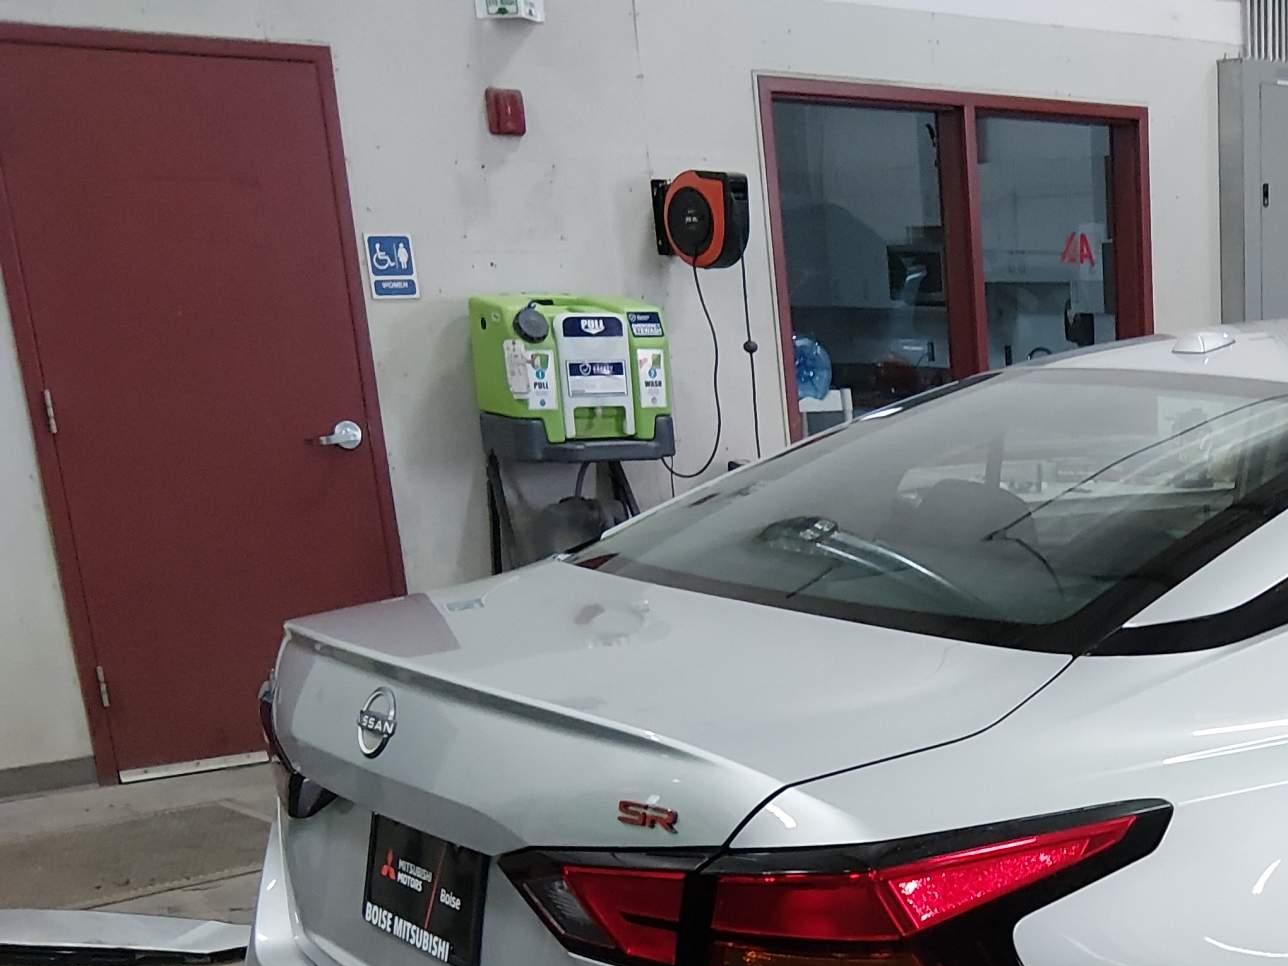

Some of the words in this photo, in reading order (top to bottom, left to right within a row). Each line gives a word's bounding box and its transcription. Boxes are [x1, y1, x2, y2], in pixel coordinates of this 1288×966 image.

[581, 319, 605, 330] PULL
[645, 380, 662, 388] WASH
[361, 714, 395, 735] SSAN
[617, 799, 679, 834] SR
[398, 858, 433, 883] MITSUBISHI
[397, 871, 423, 892] MOTORS
[440, 888, 461, 910] Boise
[365, 902, 392, 933] BOISE
[393, 916, 450, 962] MITSUBISHI
